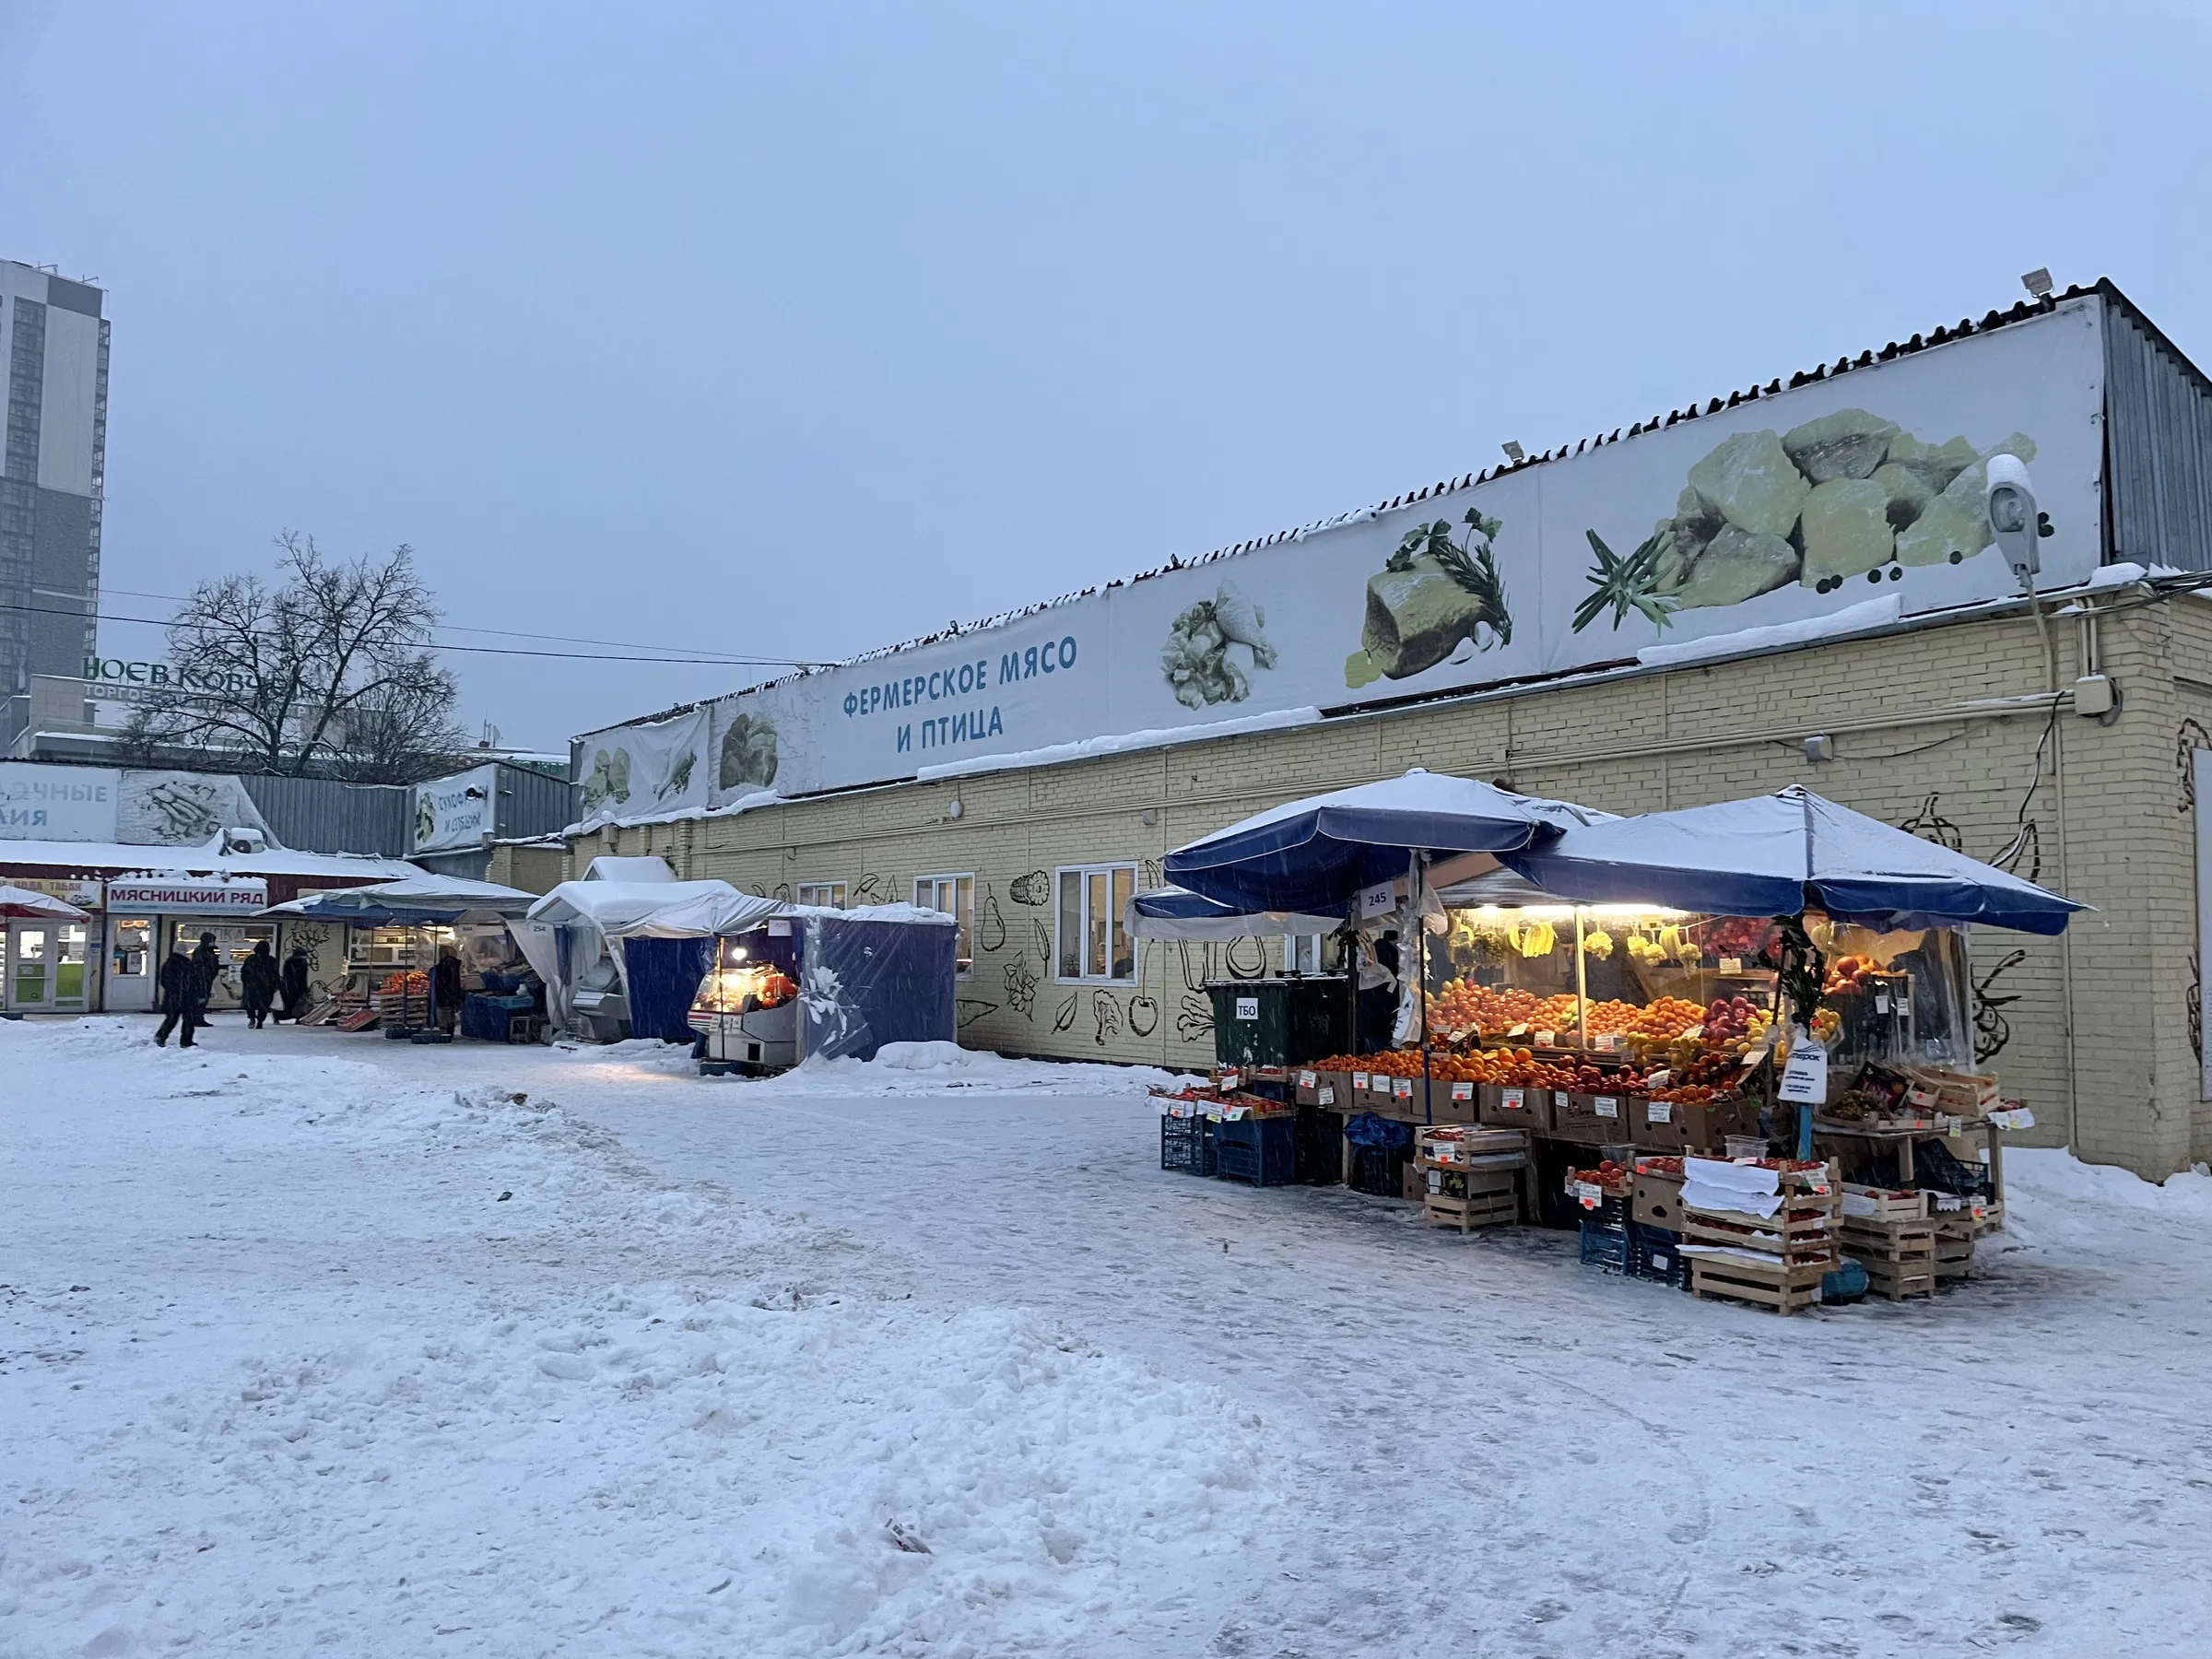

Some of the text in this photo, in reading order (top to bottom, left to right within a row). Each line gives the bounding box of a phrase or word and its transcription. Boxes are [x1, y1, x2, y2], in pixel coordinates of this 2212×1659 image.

[843, 636, 1077, 718] ФЕРМЕРСКОЕ МЯСО
[897, 706, 1004, 754] И ПТИЦА
[110, 888, 265, 905] МЯСНИЦКИЙ РЯД
[1368, 891, 1387, 907] 245
[1238, 1006, 1256, 1016] ТБО
